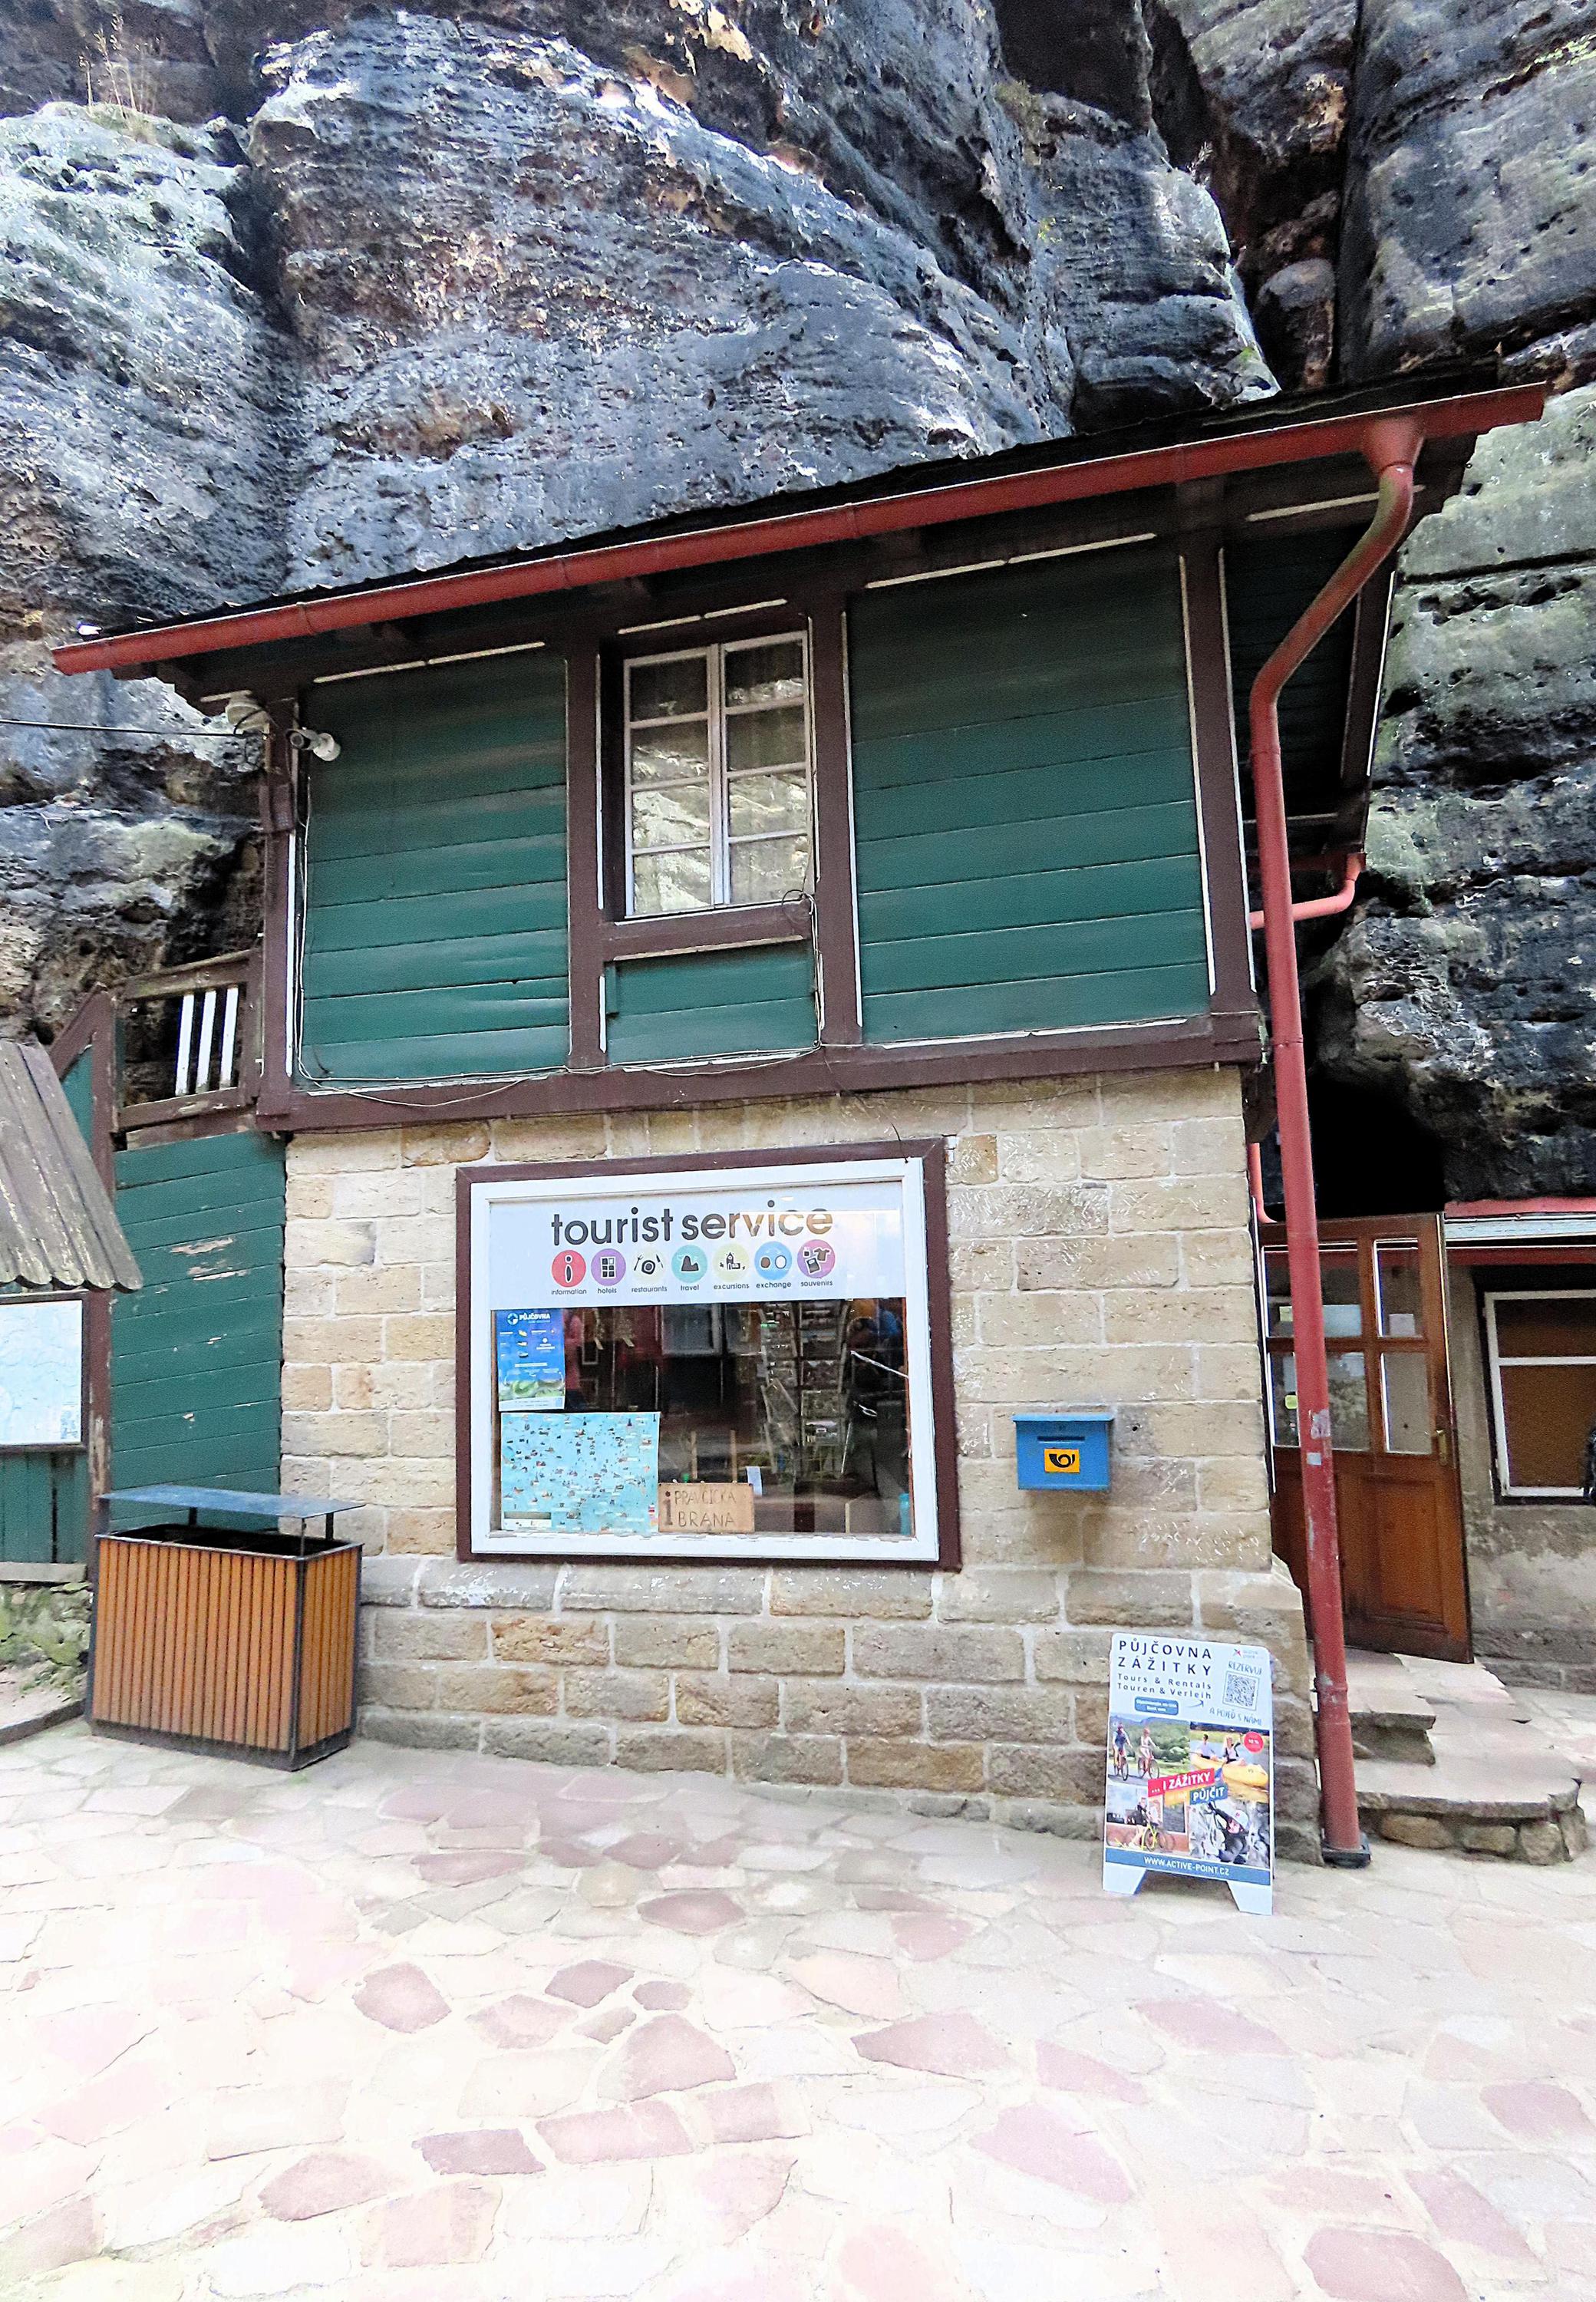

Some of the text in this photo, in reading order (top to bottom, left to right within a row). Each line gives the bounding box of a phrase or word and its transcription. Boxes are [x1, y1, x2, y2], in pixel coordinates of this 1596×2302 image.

[552, 1199, 833, 1246] tourist service
[756, 1281, 792, 1289] exchange
[678, 1511, 736, 1528] BRANA
[1119, 1637, 1212, 1660] PŮJČOVNA
[1117, 1655, 1212, 1676] ZÁŽITKY
[1118, 1673, 1147, 1683] Tours
[1168, 1678, 1212, 1690] Rentals
[1117, 1682, 1155, 1694] Touren
[1170, 1688, 1212, 1699] Verleih
[1169, 1771, 1211, 1789] ZÁŽITKY
[1192, 1786, 1225, 1802] PŮJČIT
